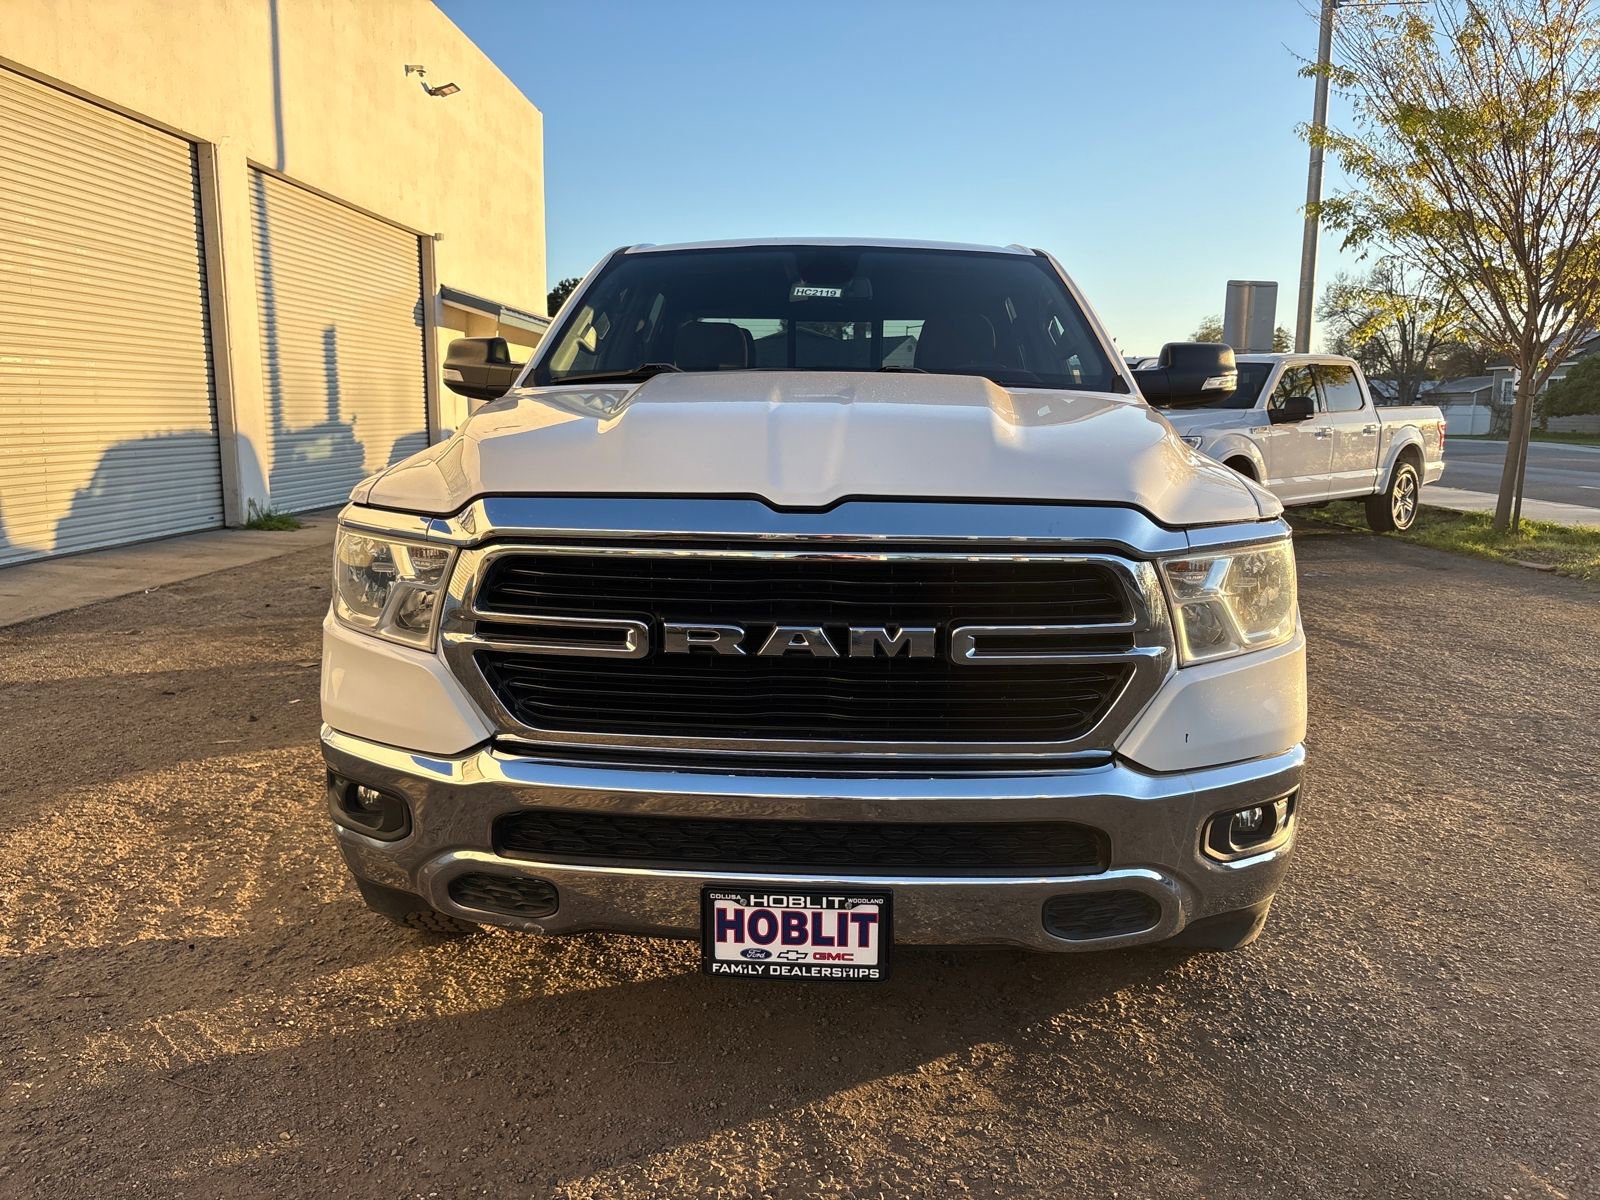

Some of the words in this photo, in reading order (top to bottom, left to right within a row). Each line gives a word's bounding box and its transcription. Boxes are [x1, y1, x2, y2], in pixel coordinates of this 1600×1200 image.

[795, 288, 837, 297] HC2119
[663, 622, 936, 658] RAM
[750, 894, 846, 909] HOBLIT
[715, 907, 879, 948] HOBLIT
[745, 948, 768, 959] Ford
[812, 952, 854, 961] GMC
[712, 963, 765, 975] FAMILY
[769, 965, 880, 978] DEALERSHIPS
